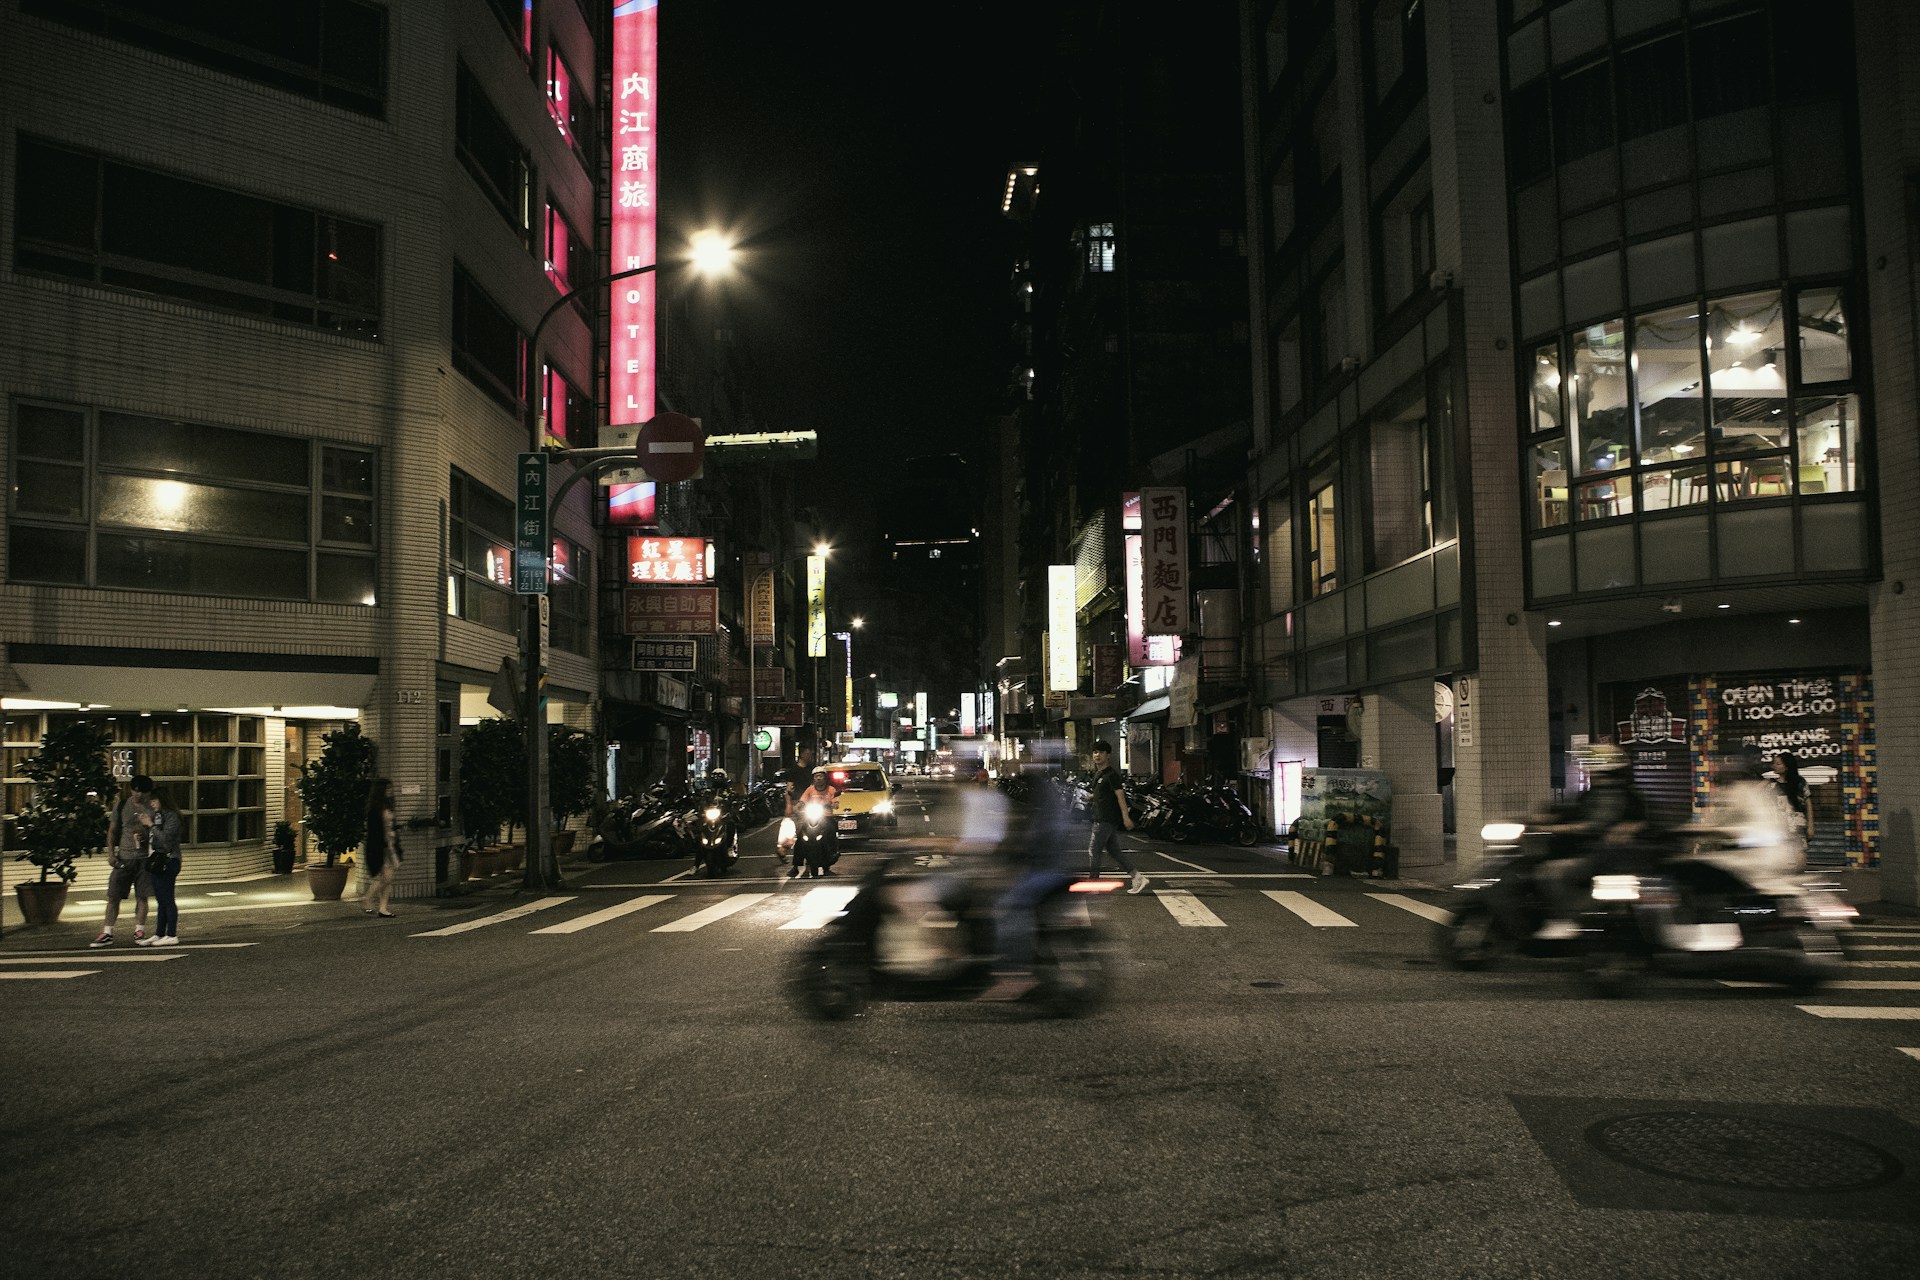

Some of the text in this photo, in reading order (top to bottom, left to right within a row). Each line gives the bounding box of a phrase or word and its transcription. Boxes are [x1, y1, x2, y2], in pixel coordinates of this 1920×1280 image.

[626, 254, 640, 409] HOTEL
[523, 470, 540, 536] 內江街
[519, 540, 533, 548] Nei
[641, 539, 686, 560] 紅星
[1151, 495, 1183, 627] 西門麵店
[628, 594, 713, 613] 永興自助餐
[397, 690, 421, 704] 112
[1721, 684, 1775, 705] OPEN
